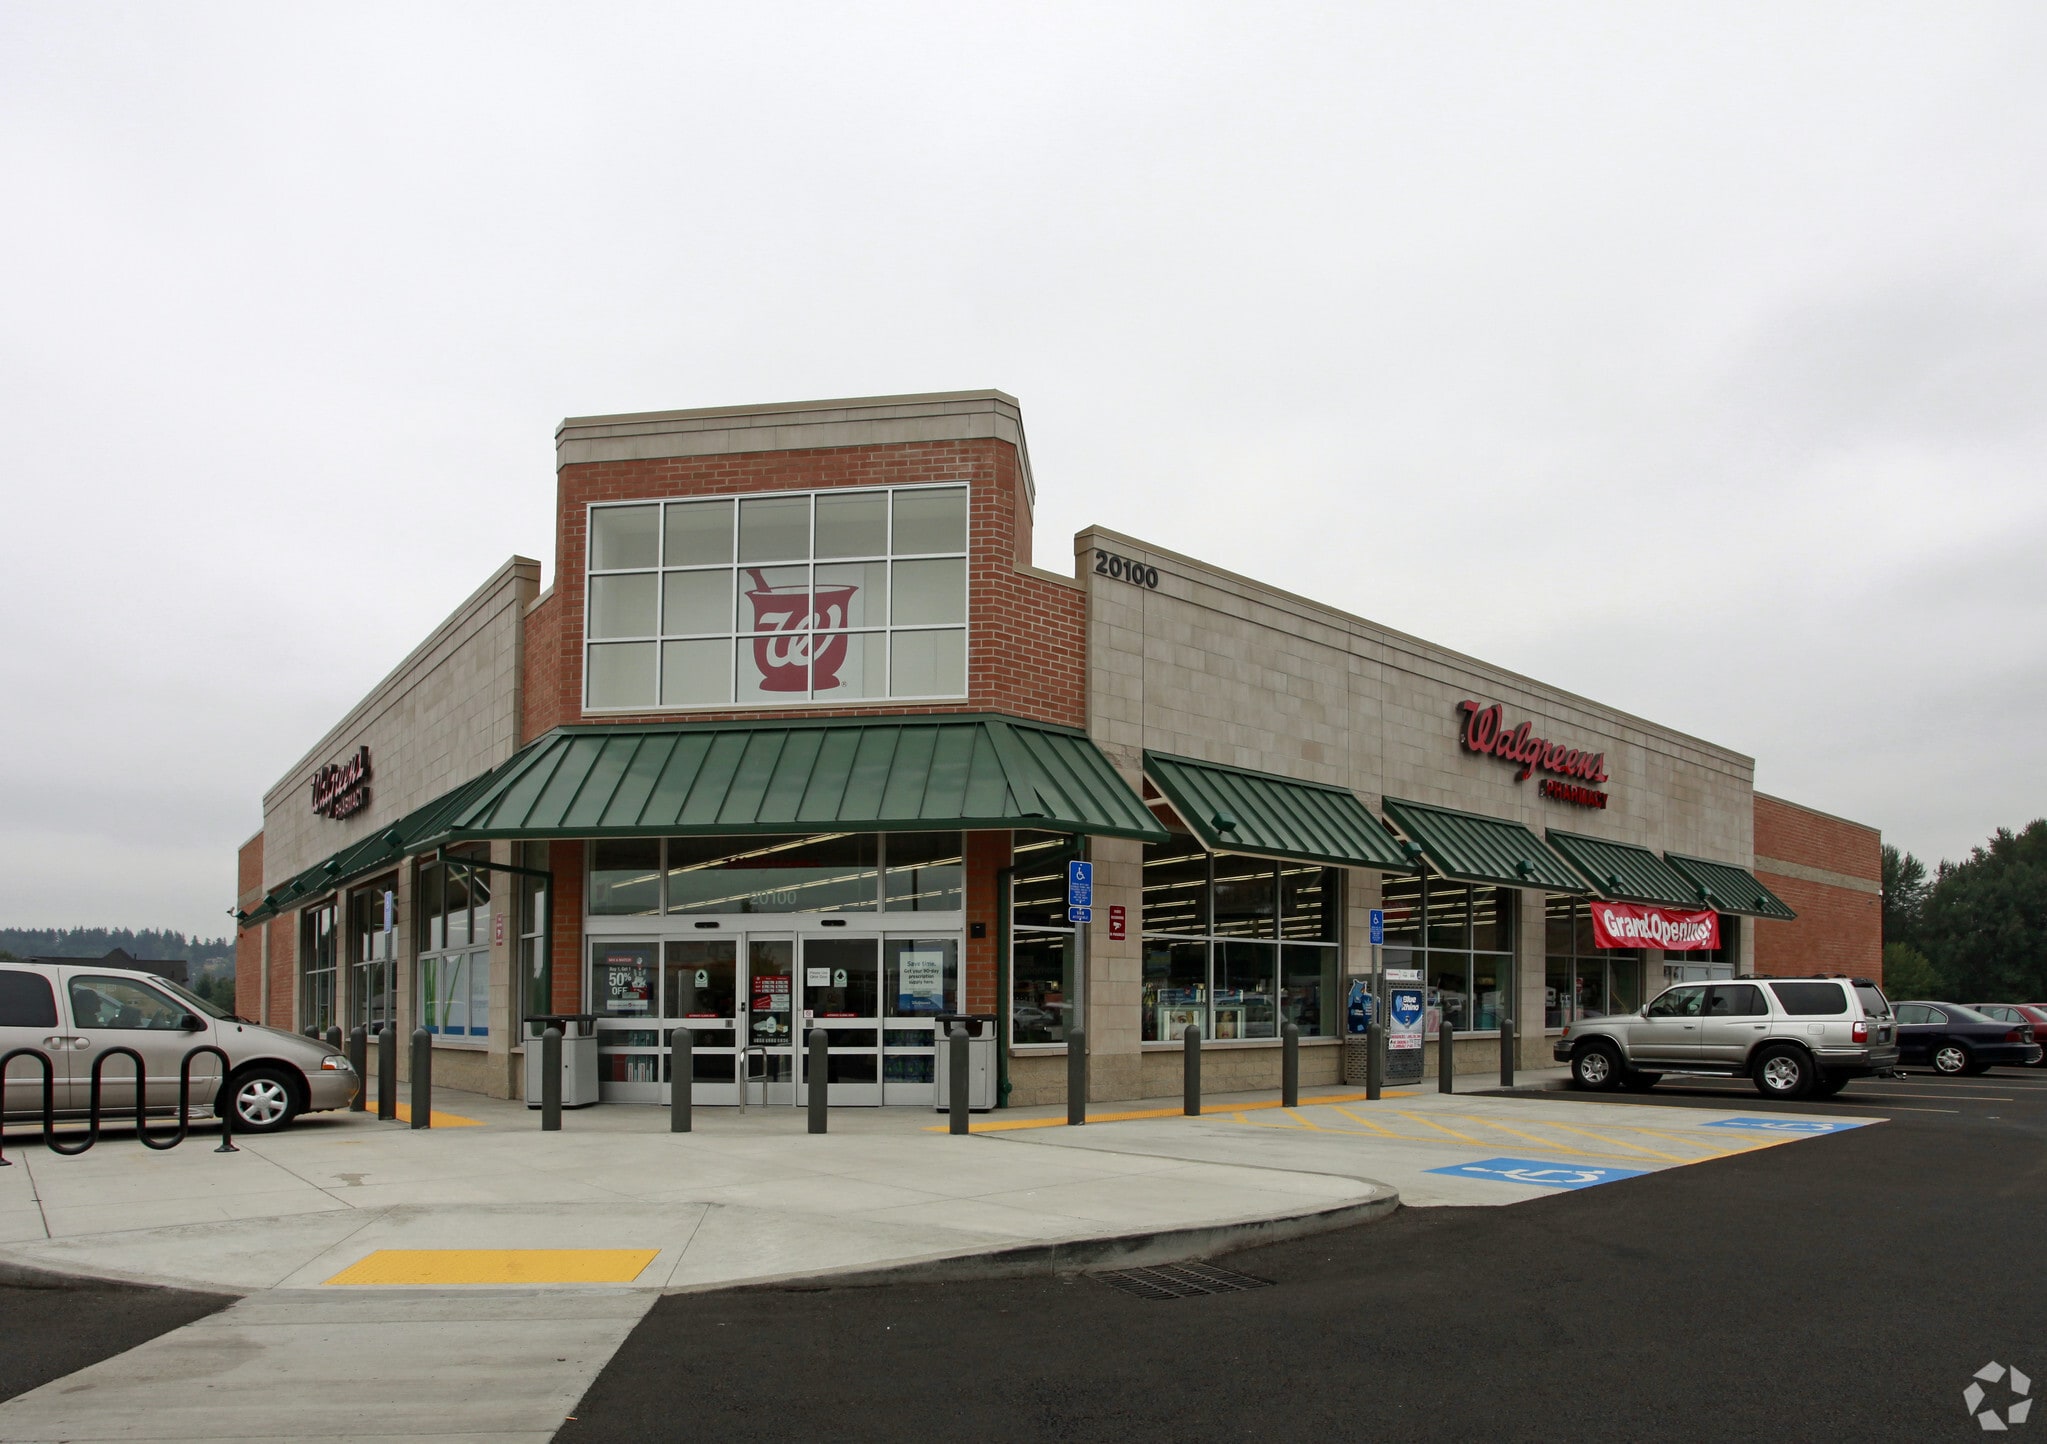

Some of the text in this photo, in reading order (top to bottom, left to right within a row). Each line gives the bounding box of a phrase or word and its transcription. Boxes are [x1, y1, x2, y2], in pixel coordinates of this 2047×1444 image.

[1096, 551, 1158, 588] 20100
[1458, 700, 1609, 782] Walgreens
[1540, 779, 1608, 809] PHARMACY
[750, 890, 797, 905] 20100
[1603, 909, 1651, 939] Grand
[609, 972, 632, 987] 50%
[612, 987, 628, 995] OFF
[1402, 995, 1417, 1003] Blue
